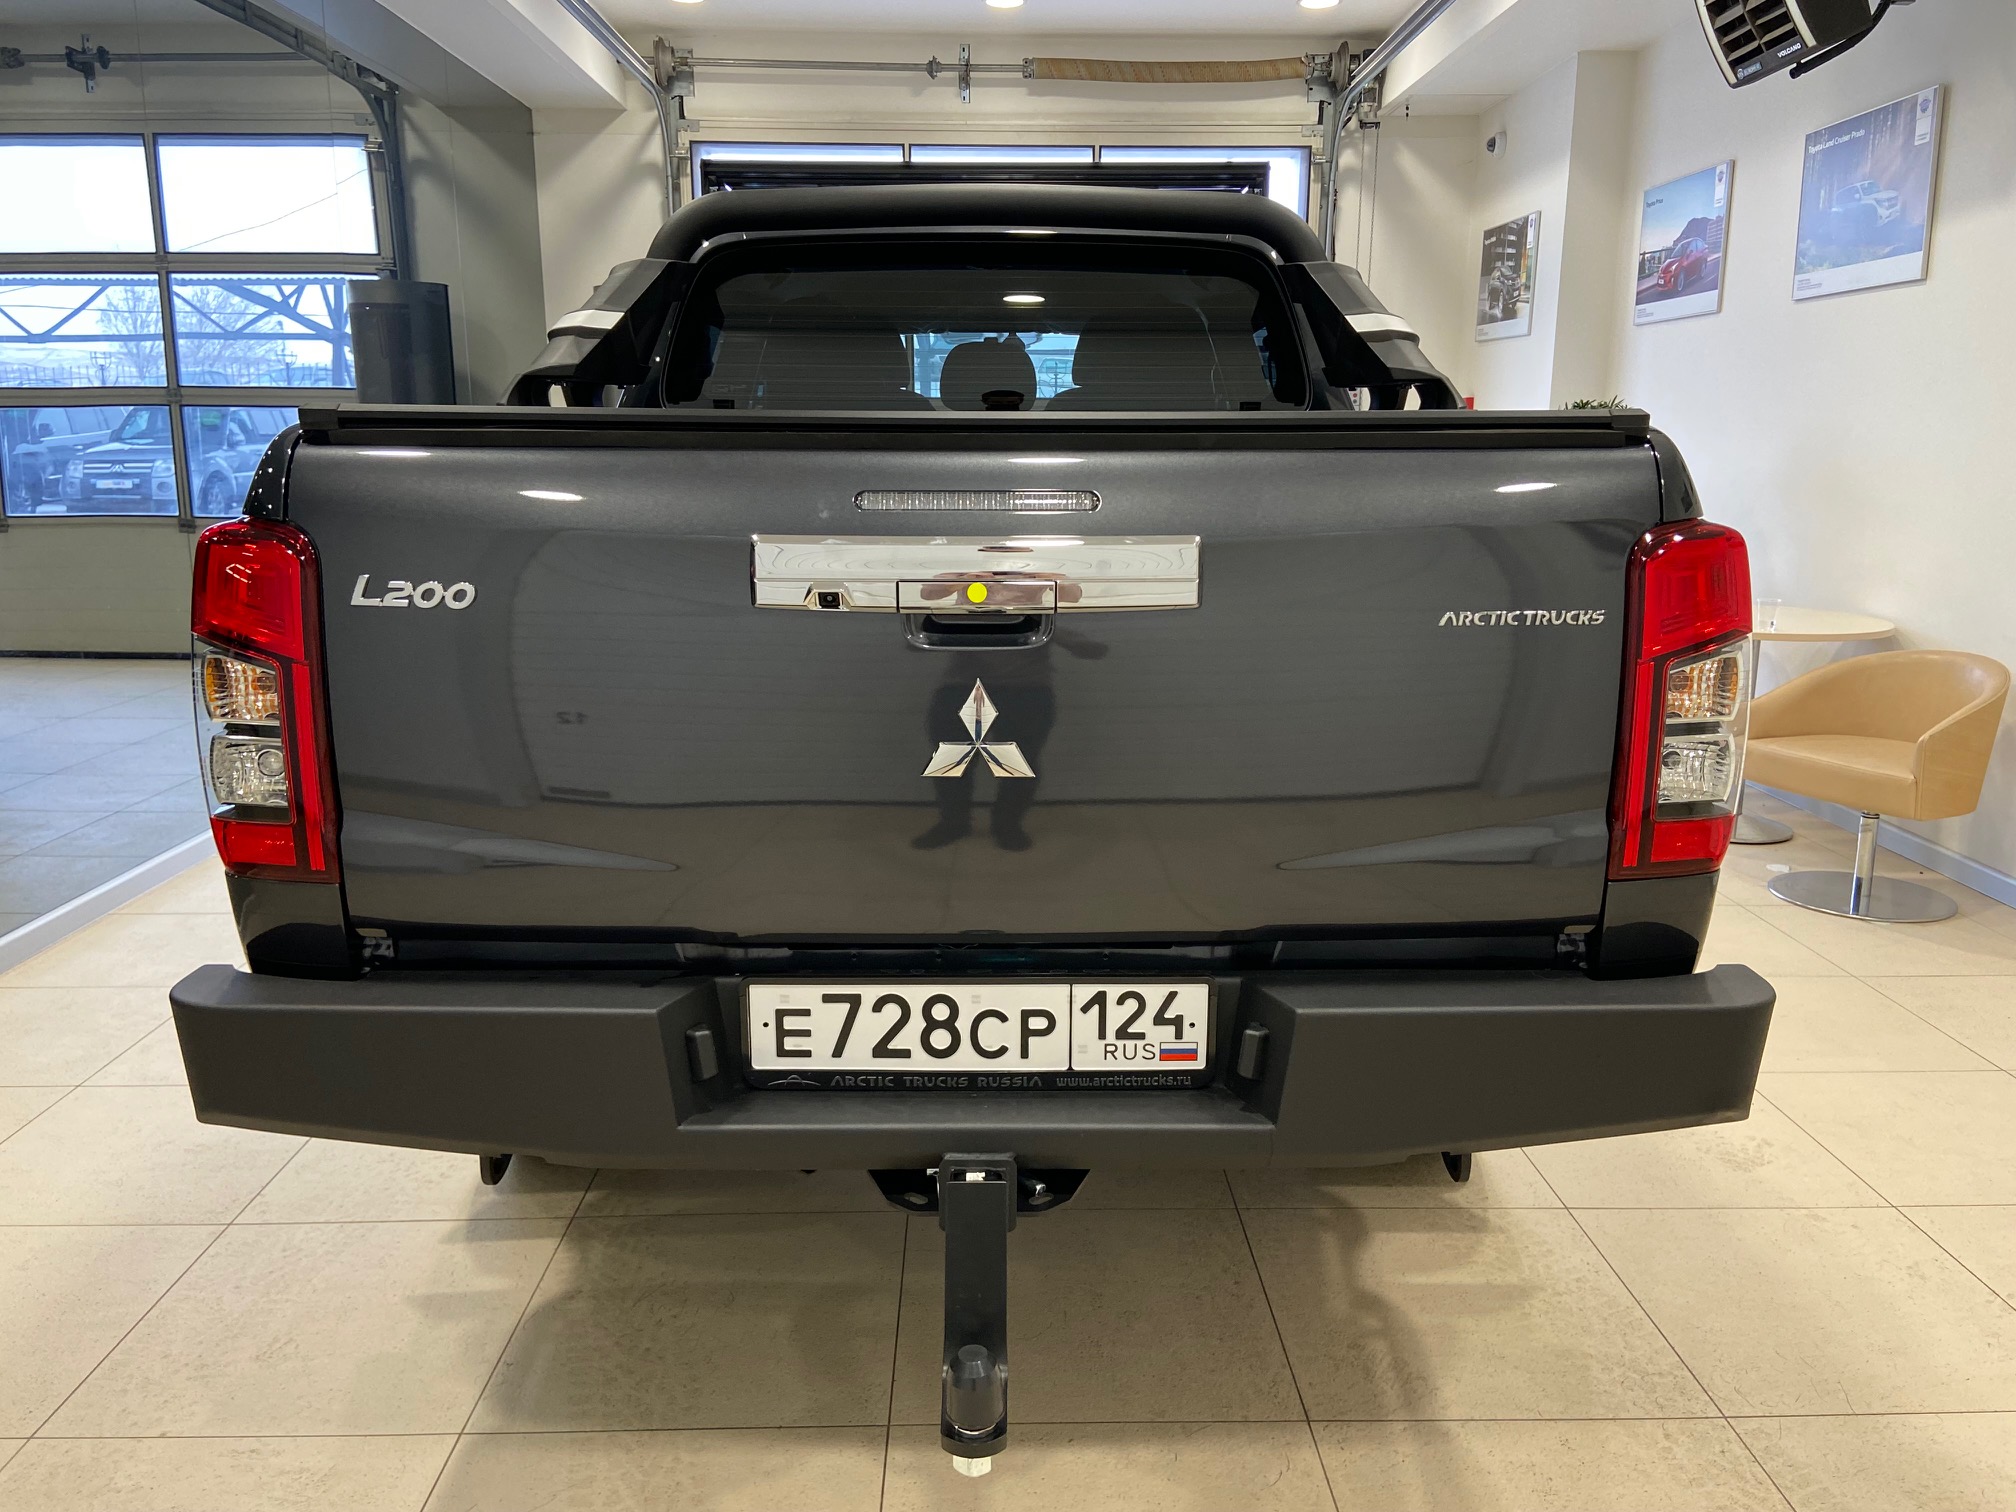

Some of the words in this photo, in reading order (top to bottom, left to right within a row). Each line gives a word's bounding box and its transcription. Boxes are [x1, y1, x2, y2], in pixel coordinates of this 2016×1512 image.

[1776, 42, 1802, 58] VOLCANO
[1808, 144, 1823, 154] Toyota
[1823, 138, 1834, 148] Land
[1835, 135, 1851, 144] Cruiser
[1851, 129, 1865, 139] Prado
[350, 574, 477, 610] L200
[1438, 610, 1521, 626] ARCTIC
[1522, 609, 1607, 626] TRUCKS
[1079, 989, 1185, 1041] 124
[1103, 1042, 1156, 1062] RUS
[830, 1075, 895, 1087] ARCTIC
[902, 1075, 969, 1088] TRUCKS
[976, 1075, 1043, 1088] RUSSIA
[1055, 1073, 1192, 1087] www.arctictrucks.ru
